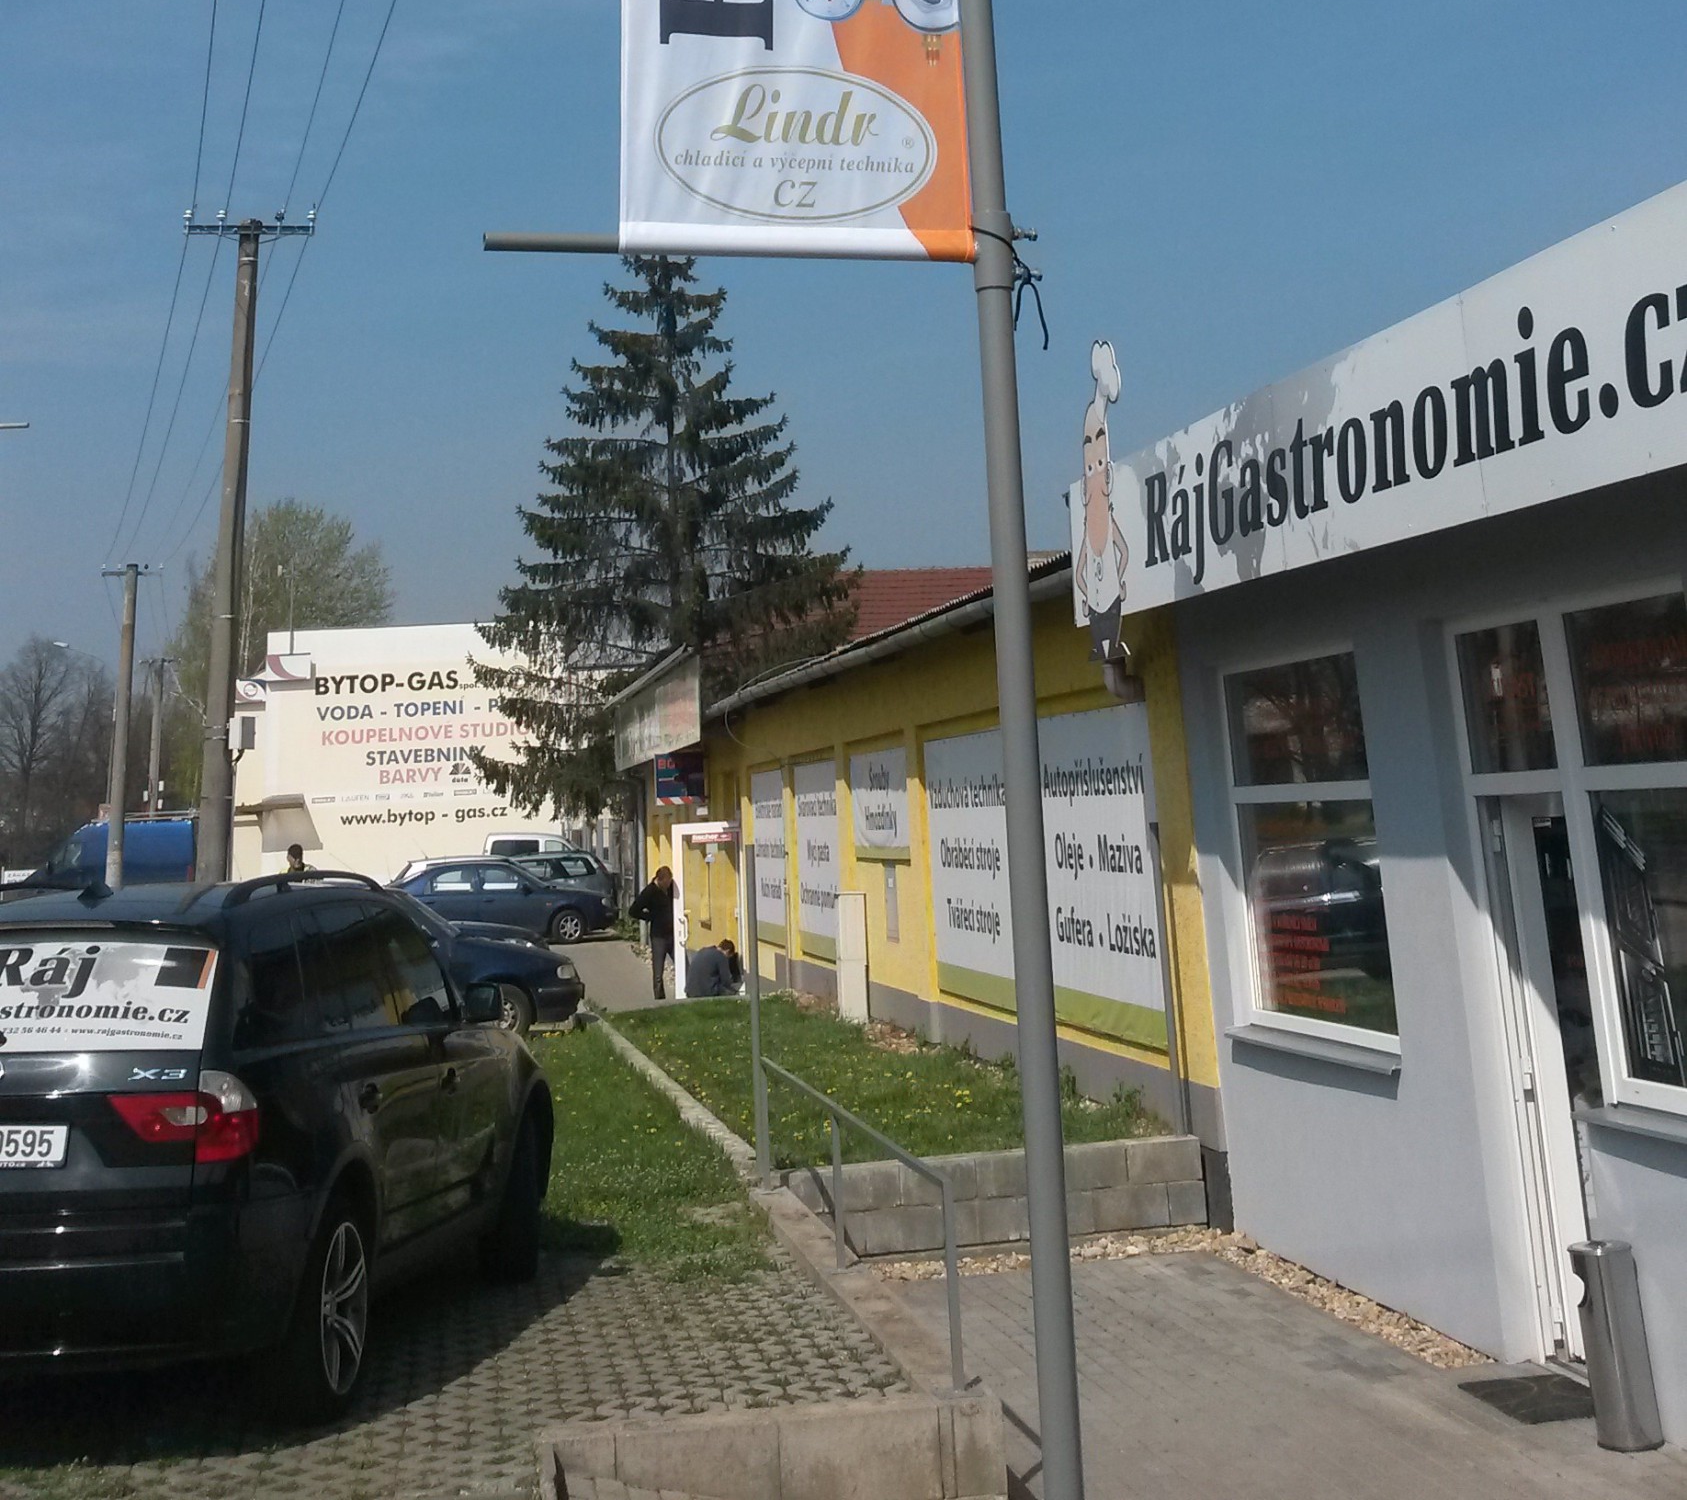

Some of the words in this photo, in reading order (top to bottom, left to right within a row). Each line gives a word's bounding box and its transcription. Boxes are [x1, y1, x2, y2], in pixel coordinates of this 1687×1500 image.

[710, 83, 879, 147] Lindr
[753, 157, 763, 168] a
[839, 155, 916, 174] technika
[773, 180, 817, 208] CZ
[1144, 284, 1687, 585] RájGastronomie.c
[315, 670, 459, 695] BYTOP-GAS
[317, 704, 373, 721] VODA
[393, 695, 464, 718] TOPENÍ
[321, 720, 453, 746] KOUPELNOVÉ
[379, 767, 442, 785] BARVY
[928, 777, 969, 809] Vzduchová
[969, 773, 1006, 808] technika
[1042, 753, 1146, 806] Autopříslušenství
[340, 808, 435, 826] www.bytop
[455, 806, 508, 823] gas.cz
[940, 837, 974, 870] Obráběcí
[976, 839, 1001, 880] stroje
[1055, 833, 1084, 880] Oleje
[1097, 833, 1143, 874] Maziva
[976, 903, 1001, 944] stroje
[1055, 907, 1094, 948] Gufera
[1108, 913, 1157, 959] Ložiska
[0, 945, 101, 999] Ráj
[49, 1026, 61, 1034] 44
[127, 1067, 188, 1081] X3
